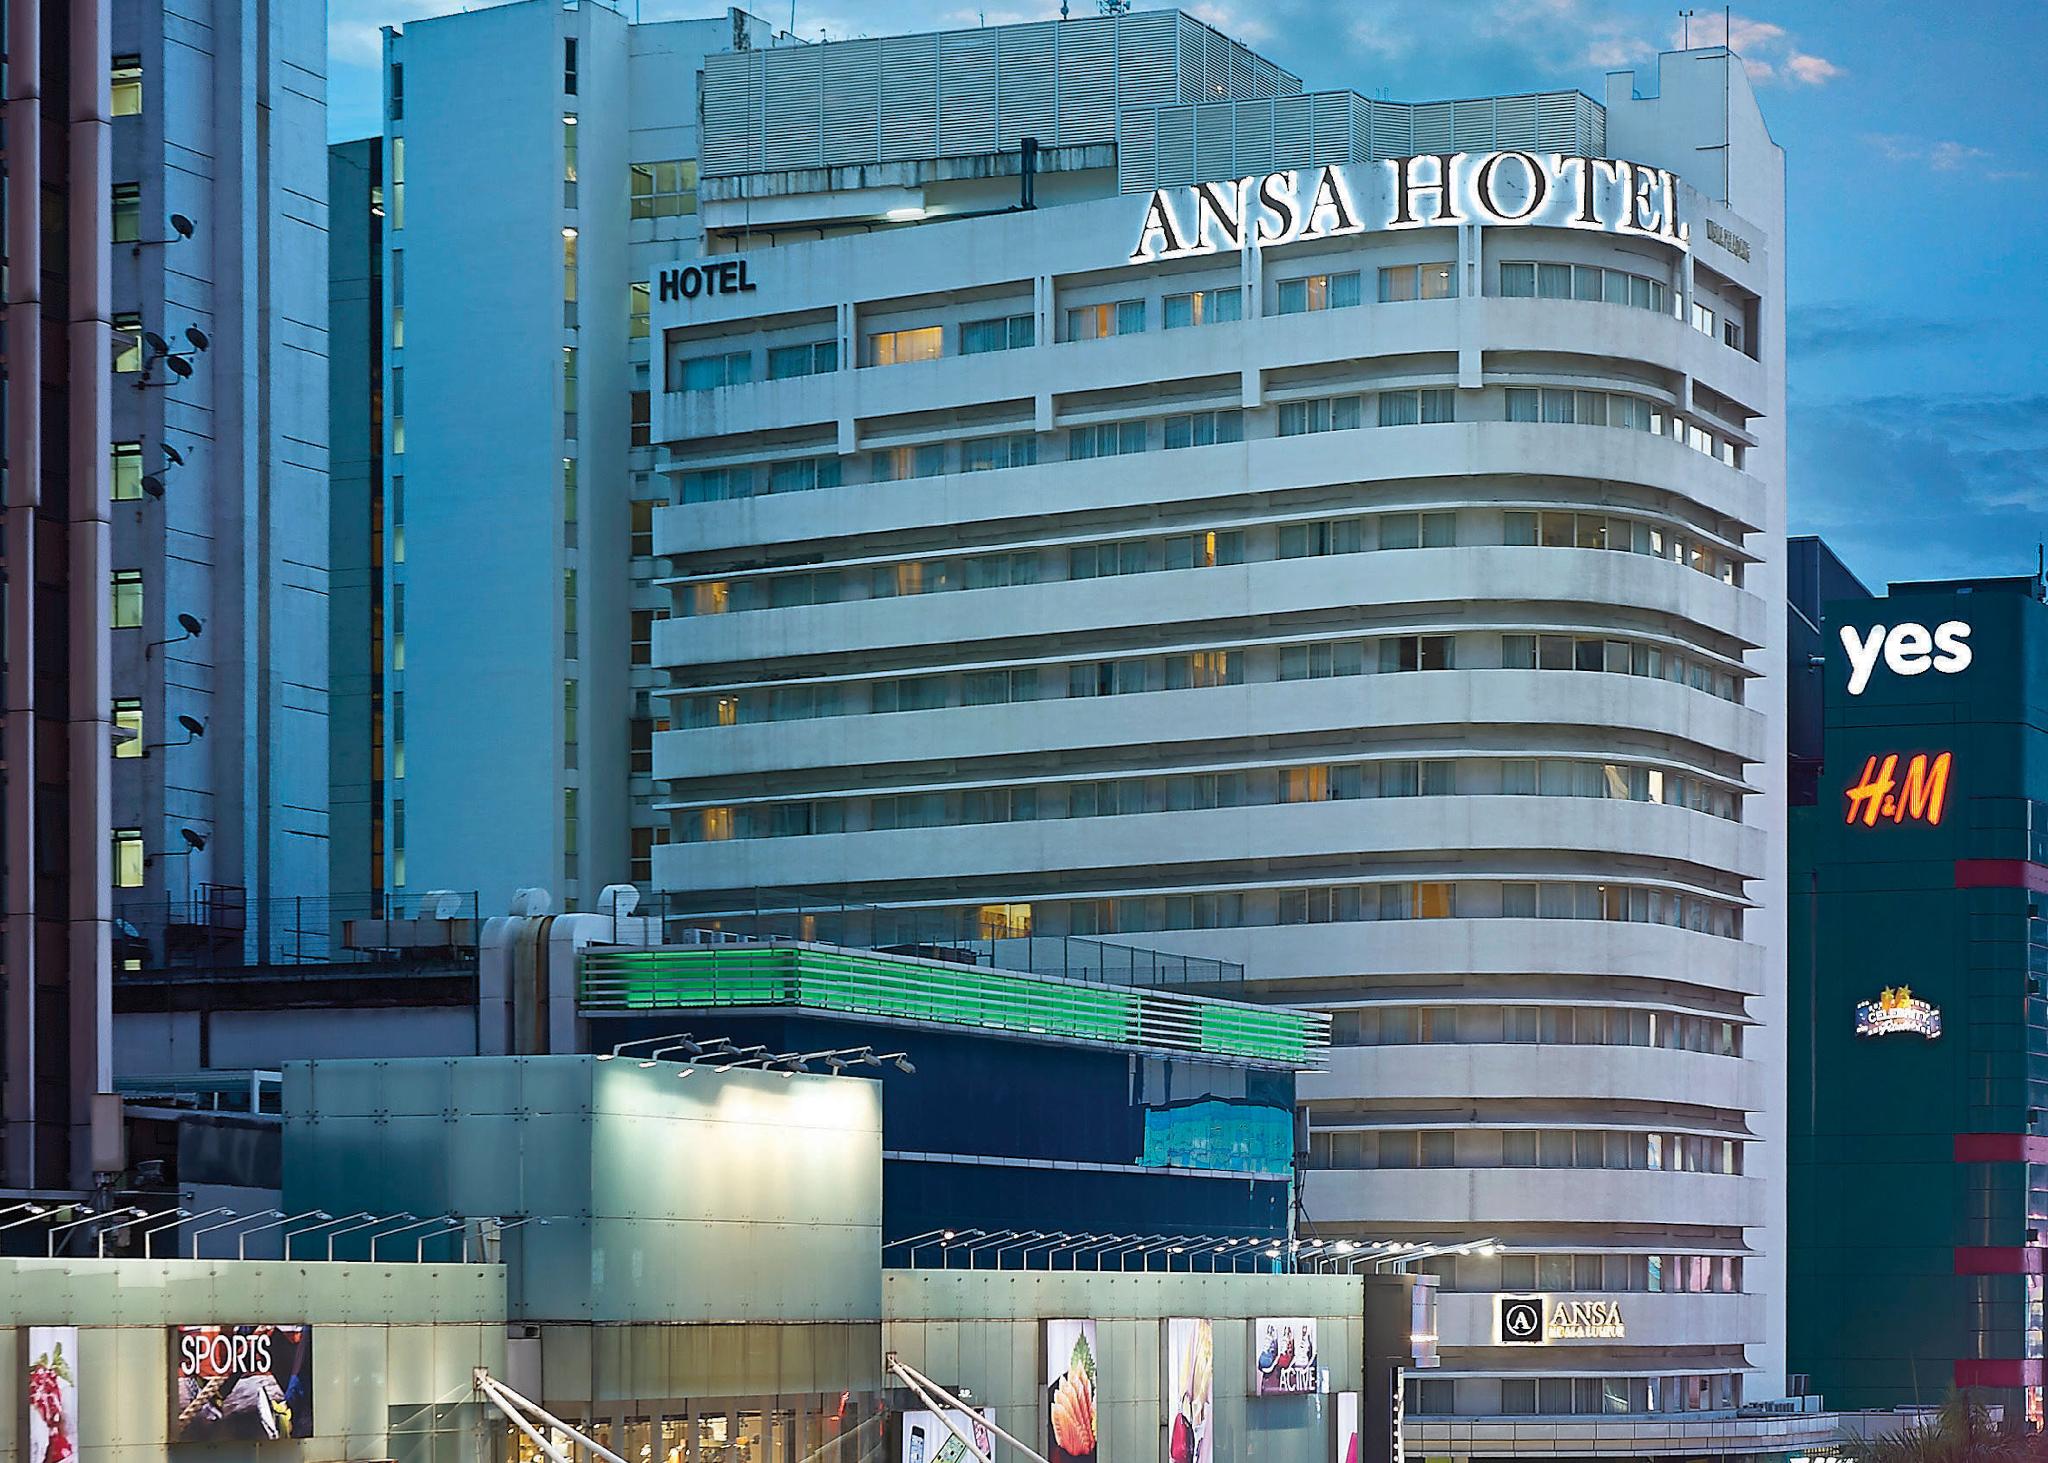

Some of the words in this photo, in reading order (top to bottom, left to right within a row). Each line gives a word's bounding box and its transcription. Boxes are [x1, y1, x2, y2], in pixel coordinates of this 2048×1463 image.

[1129, 164, 1361, 262] ANSA
[1385, 149, 1692, 251] HOTEL
[659, 260, 757, 302] HOTEL
[1839, 620, 1973, 696] yes
[1845, 751, 1953, 828] H&M
[1548, 1301, 1625, 1327] ANSA
[180, 1333, 272, 1376] SPORTS
[1279, 1366, 1316, 1392] ACTIVE
